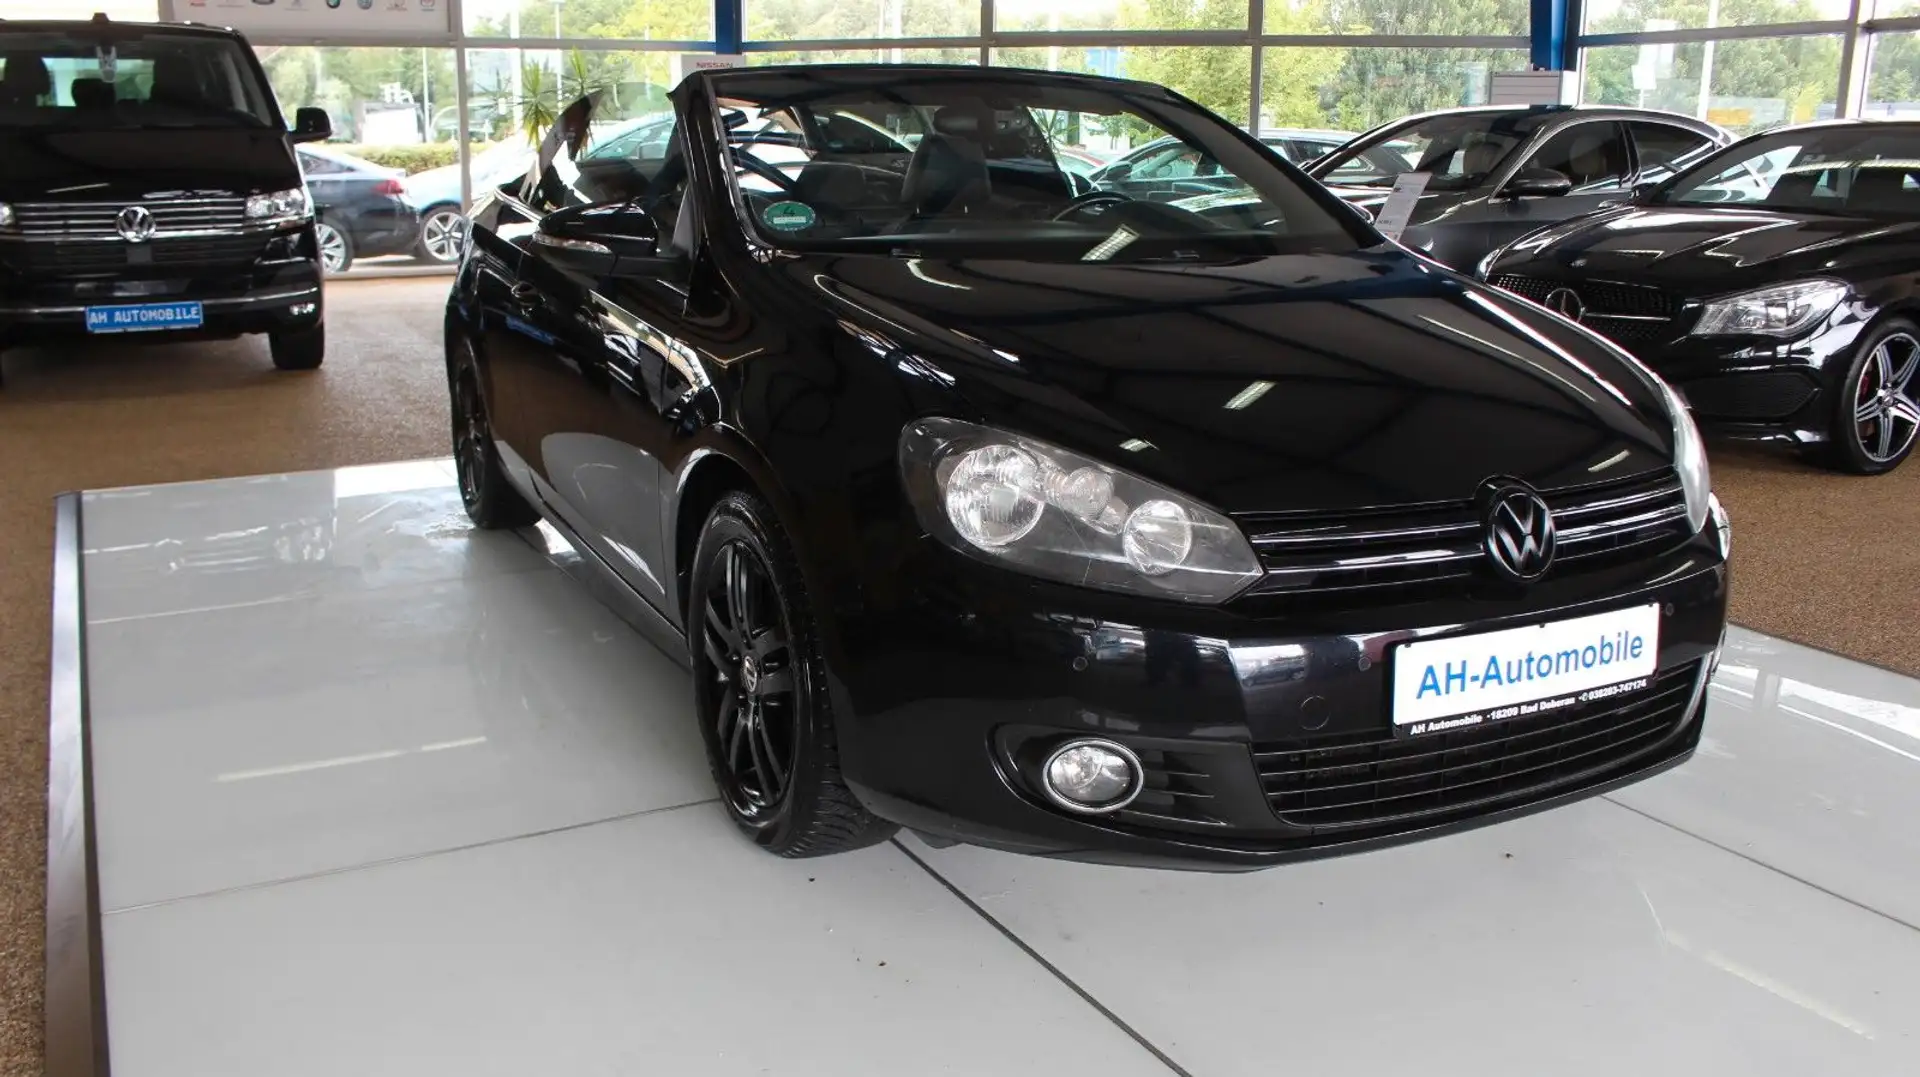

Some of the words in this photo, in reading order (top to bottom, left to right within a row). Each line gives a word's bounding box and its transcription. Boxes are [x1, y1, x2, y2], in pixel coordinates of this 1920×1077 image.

[783, 205, 795, 216] 4
[90, 311, 108, 324] AH
[114, 306, 201, 323] AUTOMOBILE
[1416, 630, 1643, 699] AH-Automobile
[1410, 723, 1426, 735] AH
[1427, 714, 1483, 731] Automobile
[1520, 703, 1539, 715] Bad
